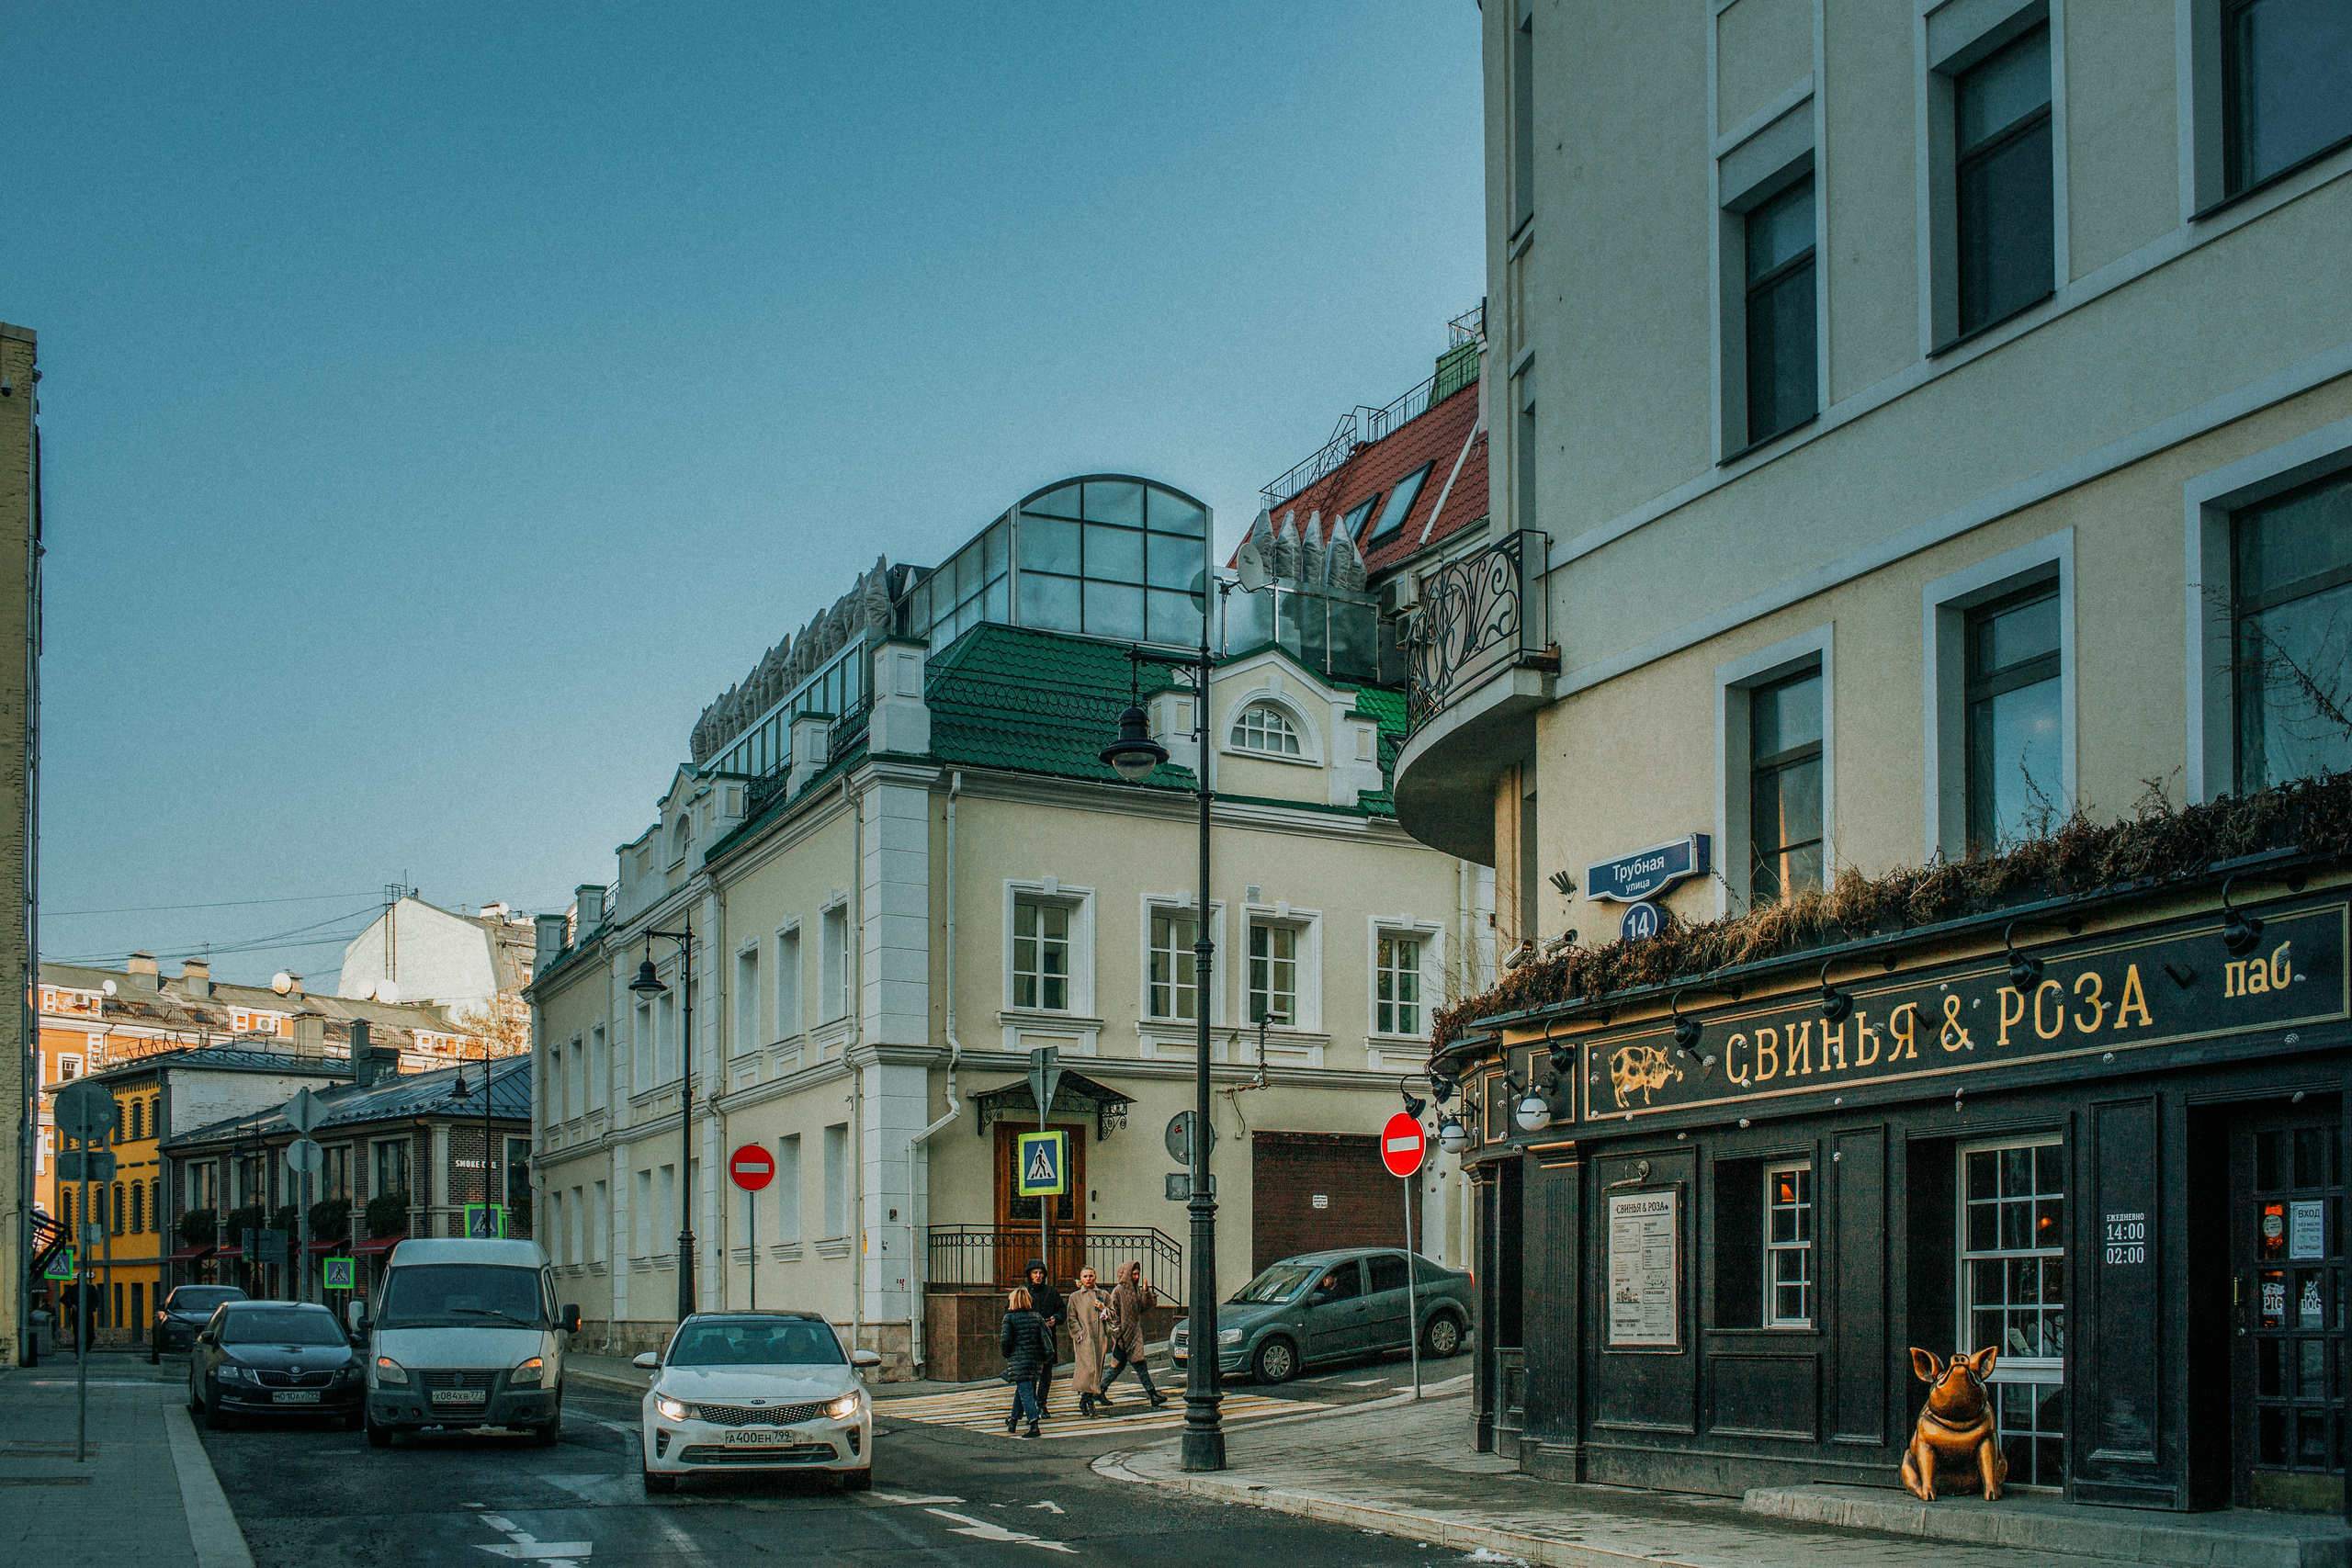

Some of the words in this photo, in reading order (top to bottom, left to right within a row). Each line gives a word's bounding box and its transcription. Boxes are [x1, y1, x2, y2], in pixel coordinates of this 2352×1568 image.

[1612, 856, 1665, 883] Трубная
[1625, 879, 1650, 895] улица
[1628, 911, 1650, 942] 14
[1725, 1002, 1918, 1085] СВИНЬЯ
[1940, 994, 1973, 1052] &
[1996, 964, 2154, 1046] РОЗА
[2223, 940, 2291, 998] паб
[455, 1159, 481, 1168] SMOKE
[1616, 1202, 1642, 1214] СВИНЬЯ
[1642, 1202, 1647, 1213] &
[1647, 1201, 1665, 1213] РОЗА
[2298, 1208, 2321, 1220] ВХОД
[2106, 1213, 2144, 1222] ЕЖЕДНЕВНО
[2106, 1223, 2144, 1240] 14:00
[2106, 1247, 2144, 1265] 02:00
[2263, 1296, 2283, 1310] PIG
[2301, 1298, 2322, 1310] DOG
[774, 1430, 790, 1440] 799
